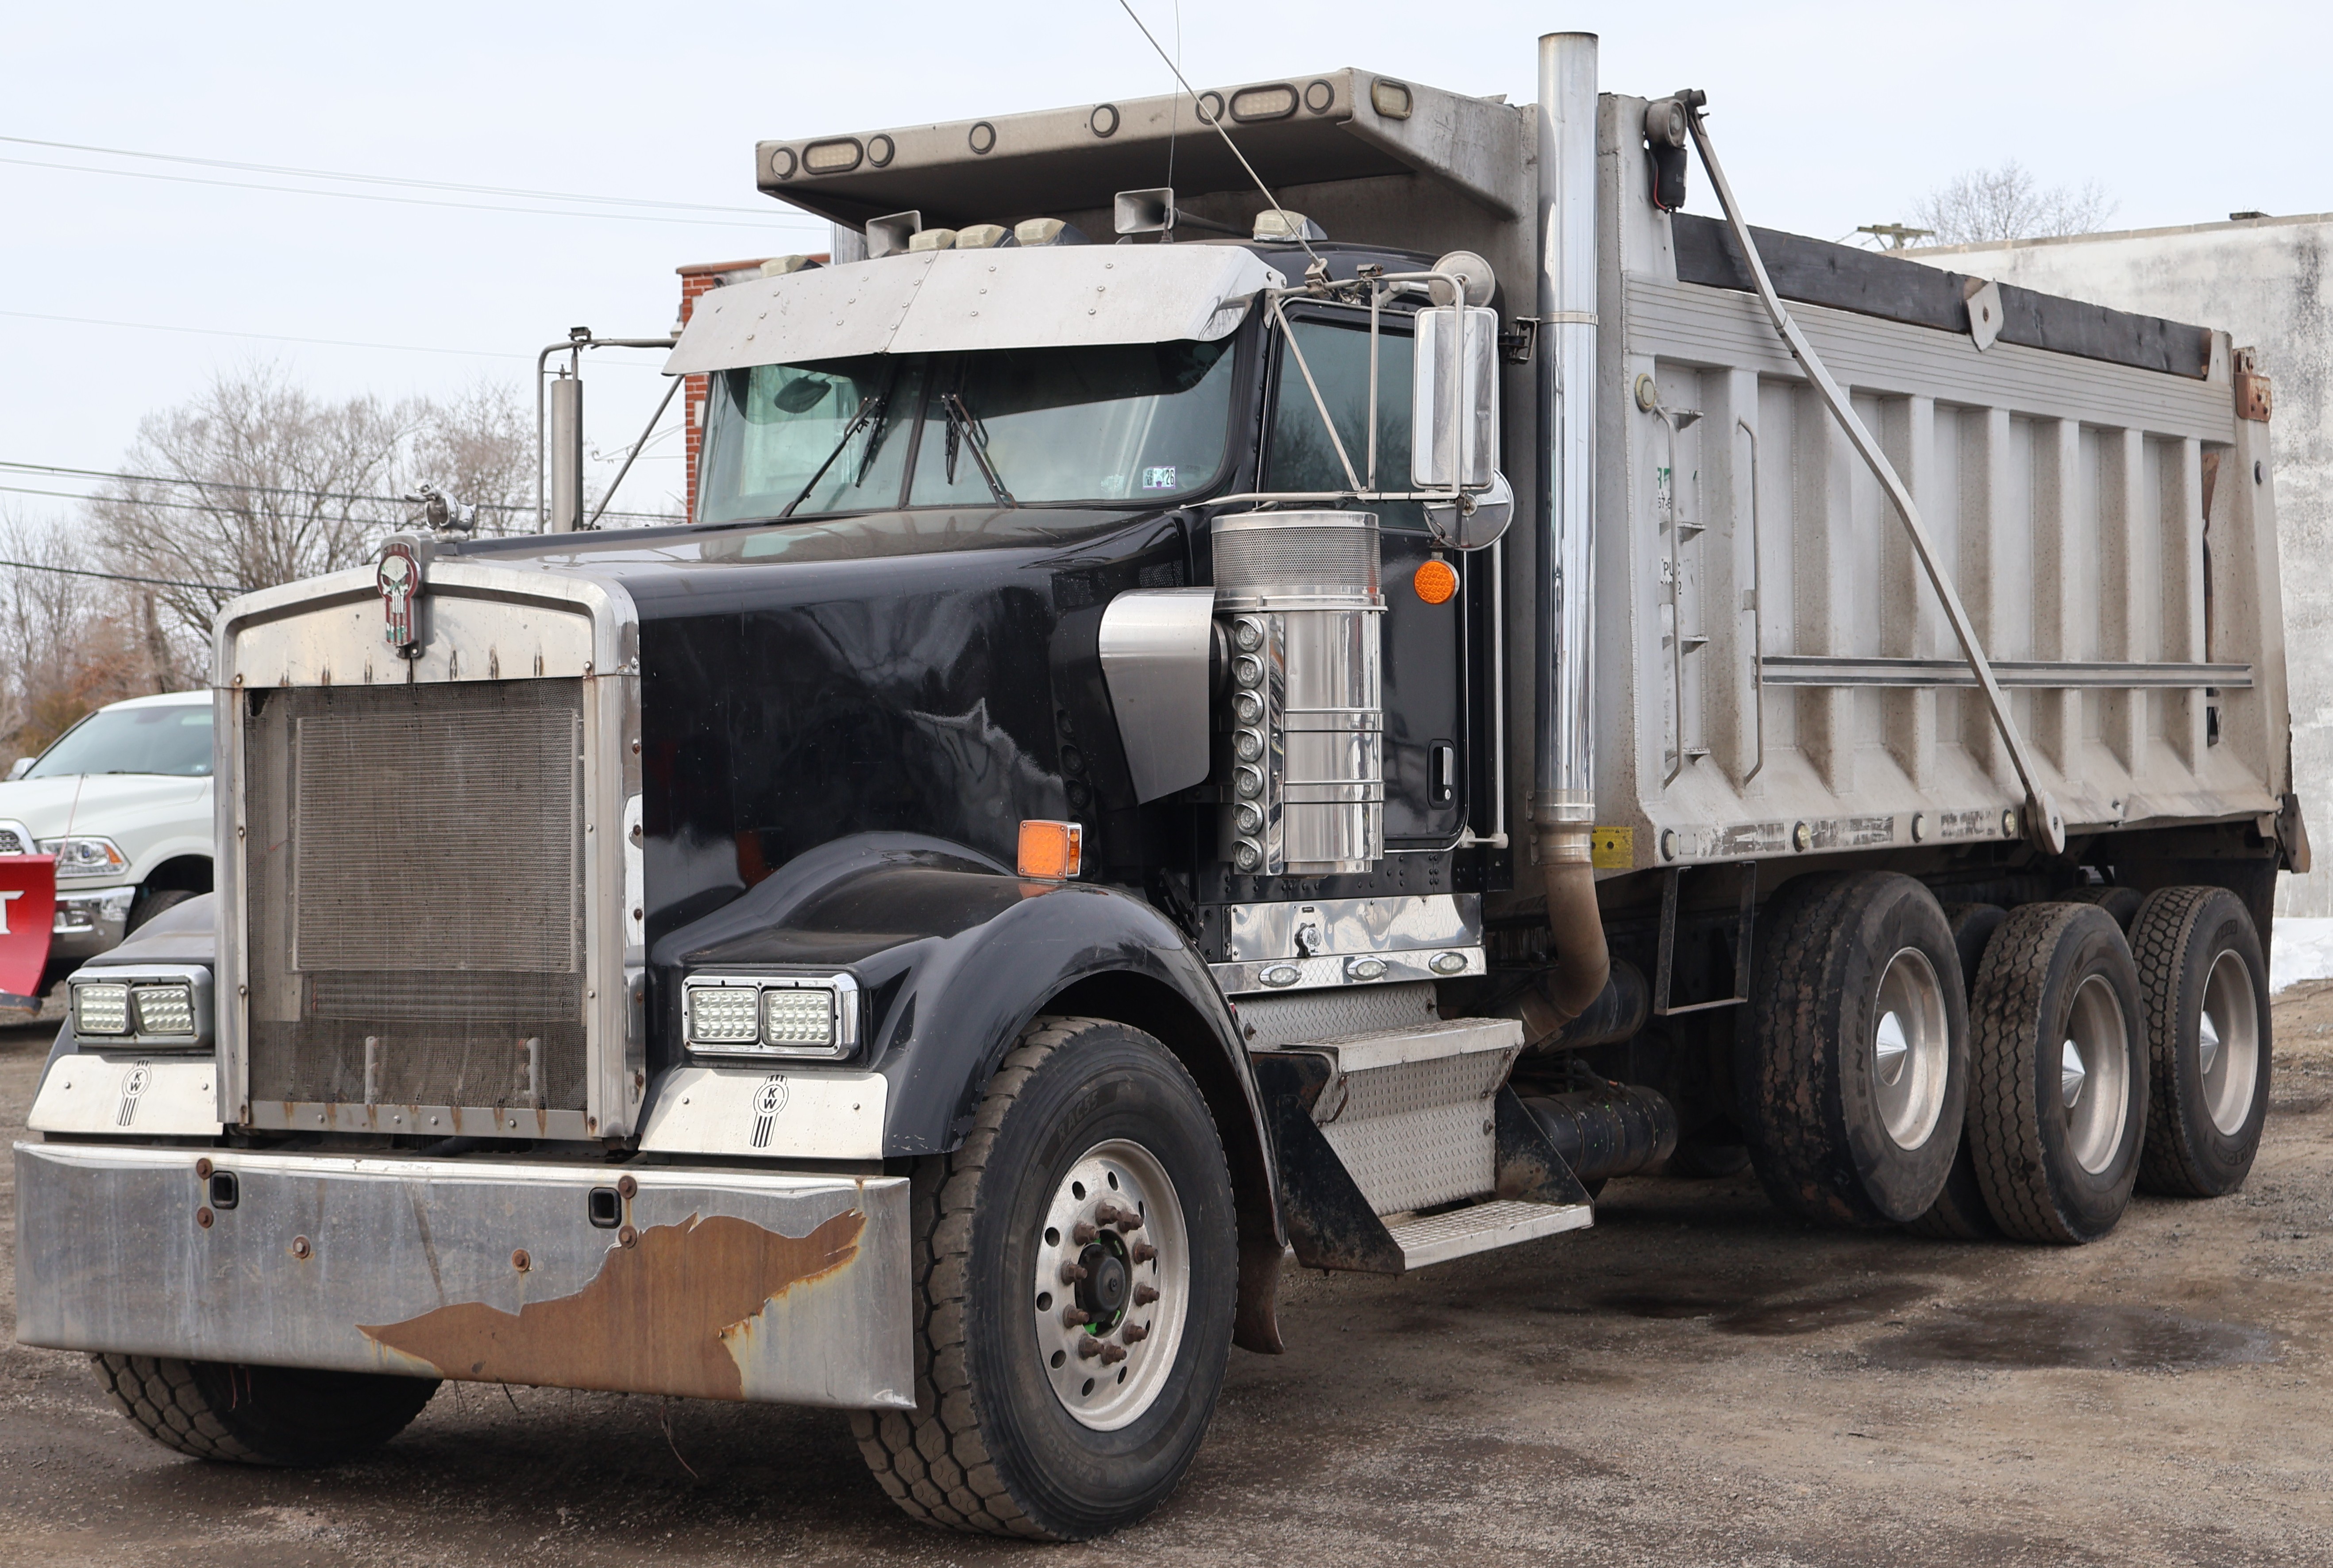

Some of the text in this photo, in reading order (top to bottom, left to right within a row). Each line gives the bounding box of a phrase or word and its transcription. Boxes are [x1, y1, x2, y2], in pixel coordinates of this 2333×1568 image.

[1166, 469, 1174, 485] 26
[767, 1088, 778, 1098] K
[764, 1098, 778, 1109] W
